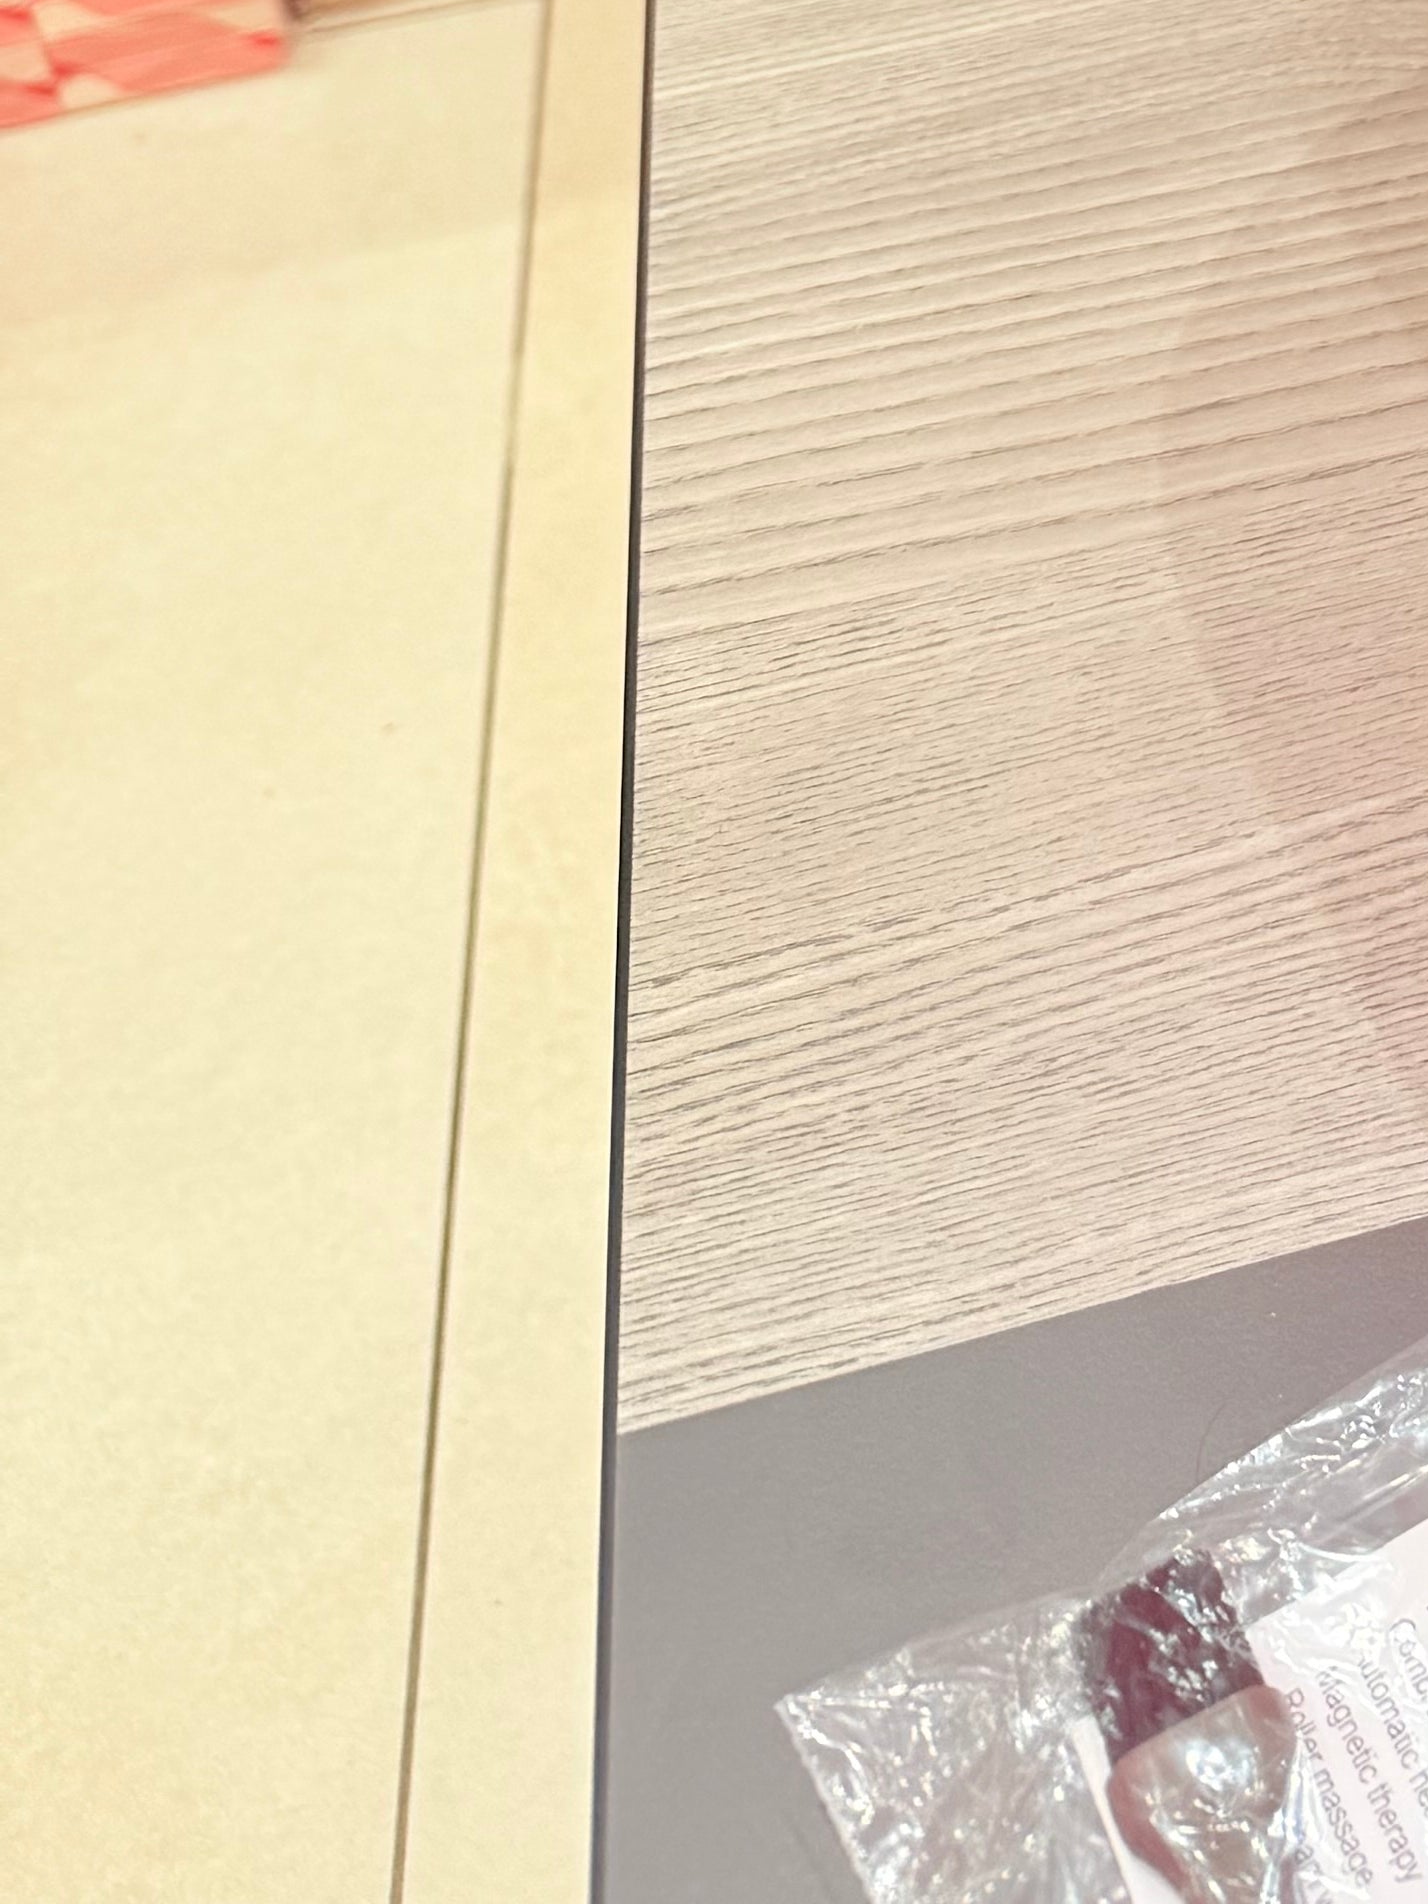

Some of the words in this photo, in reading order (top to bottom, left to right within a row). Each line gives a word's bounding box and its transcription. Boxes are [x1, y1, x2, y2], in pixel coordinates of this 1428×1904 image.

[1284, 1687, 1324, 1765] Roller
[1312, 1766, 1375, 1889] massage
[1367, 1781, 1423, 1884] therapy
